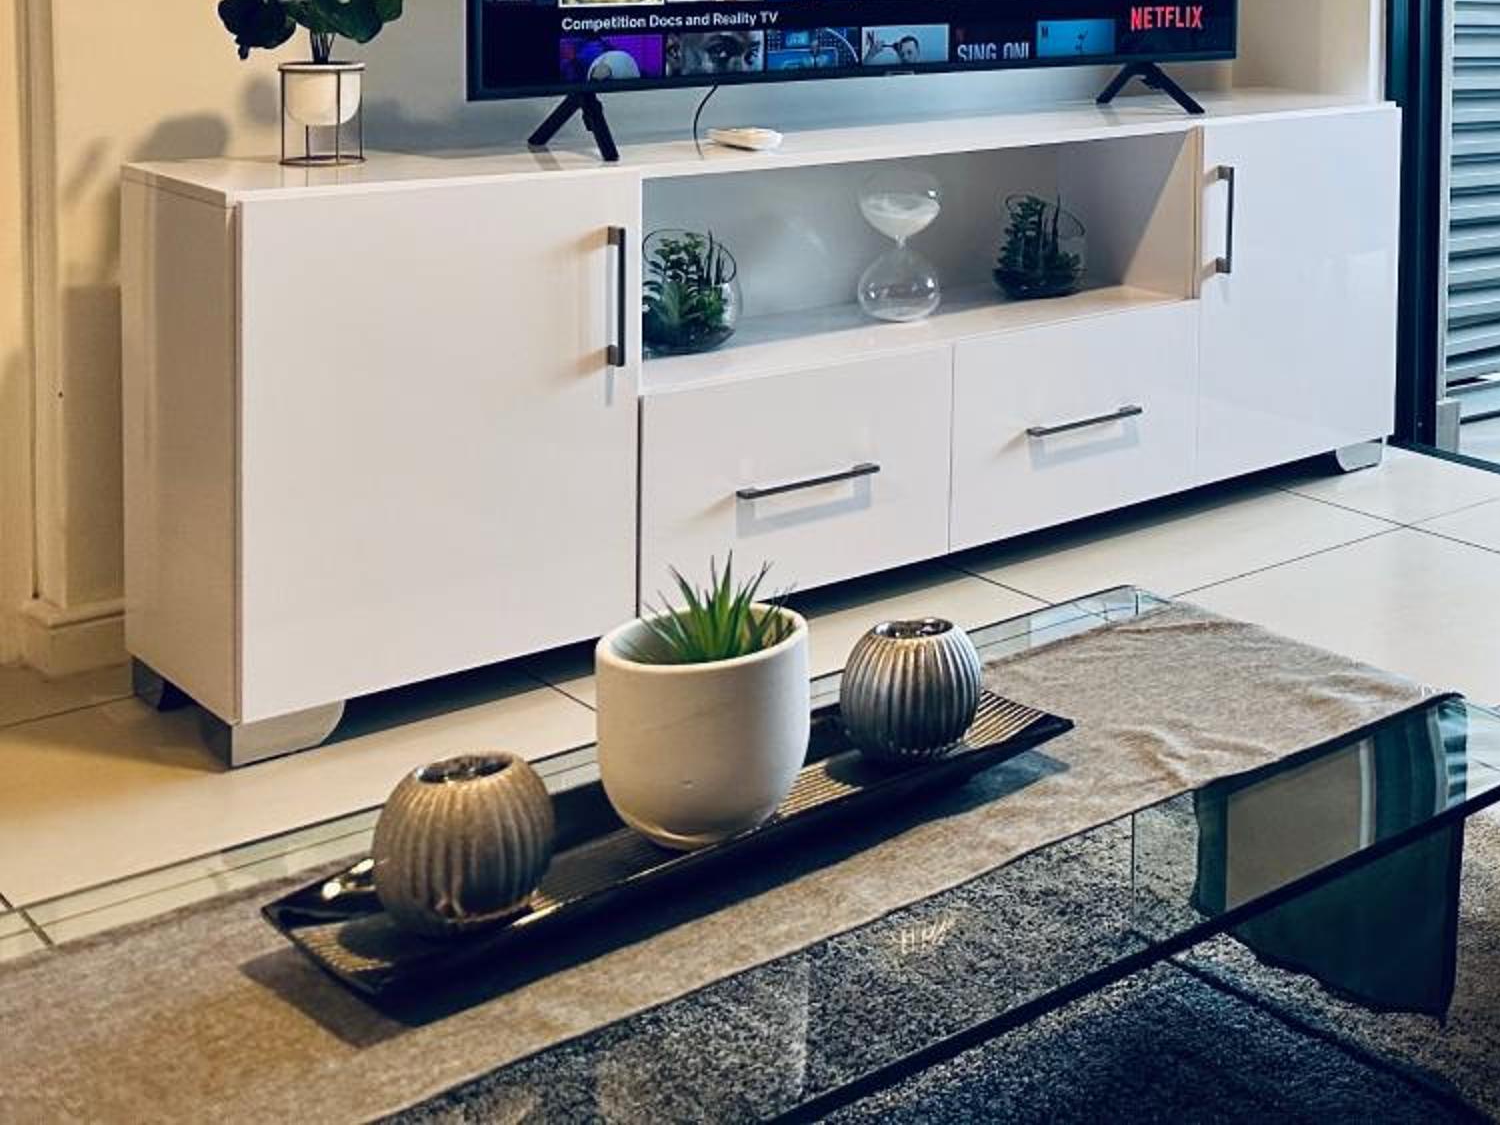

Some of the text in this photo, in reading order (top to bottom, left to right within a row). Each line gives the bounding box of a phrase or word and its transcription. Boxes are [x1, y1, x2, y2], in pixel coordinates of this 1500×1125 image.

[562, 11, 779, 32] Competition Docs and Reality TV
[1131, 5, 1203, 32] NETFLIX
[958, 43, 997, 61] SING
